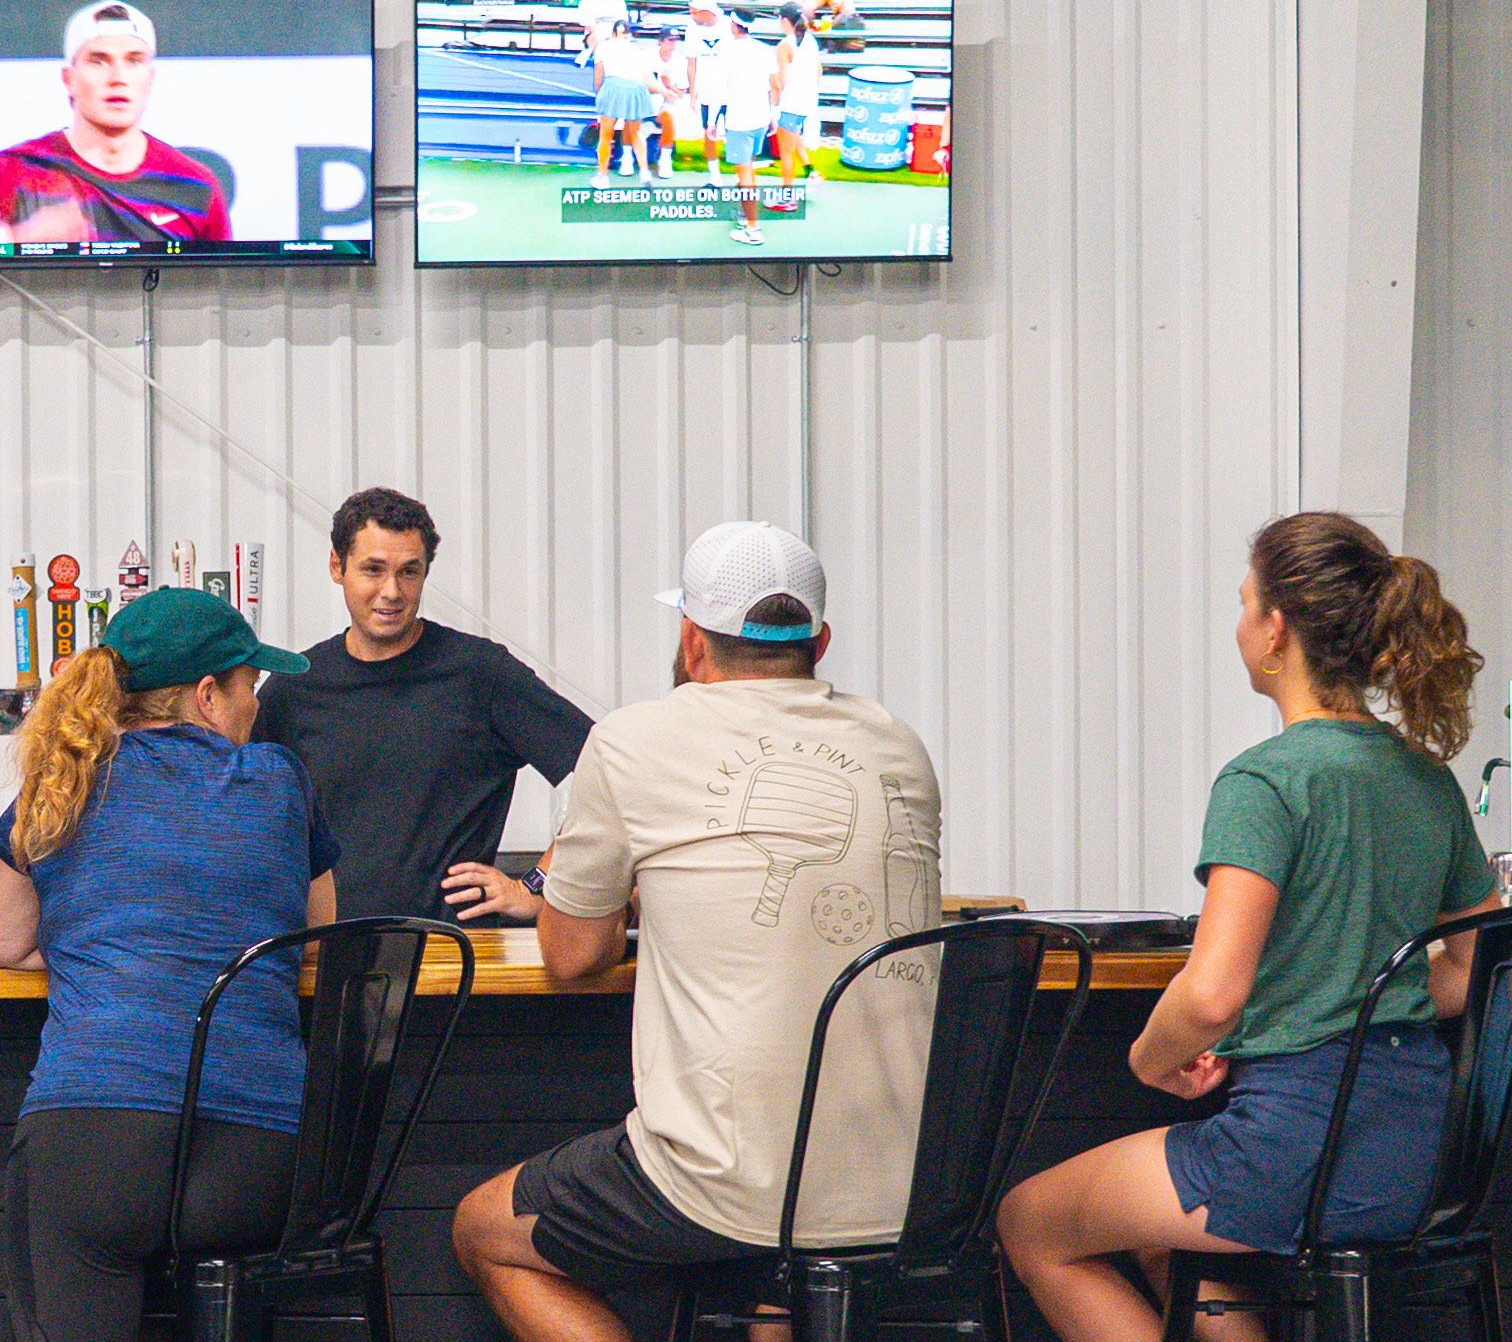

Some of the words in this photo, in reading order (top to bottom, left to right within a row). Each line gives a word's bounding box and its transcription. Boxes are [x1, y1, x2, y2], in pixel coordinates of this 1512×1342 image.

[563, 191, 591, 204] ATP
[593, 190, 651, 204] SEEMED
[653, 190, 673, 203] TO
[676, 190, 694, 203] BE
[697, 189, 718, 203] ON
[721, 189, 760, 202] BOTH
[762, 188, 806, 202] THEIR
[650, 205, 717, 219] PADDLES.
[125, 550, 141, 564] 48
[248, 550, 260, 595] ULTRA
[56, 603, 74, 655] HOB
[704, 736, 776, 830] PICKLE
[792, 742, 806, 753] &
[814, 743, 867, 776] PINT
